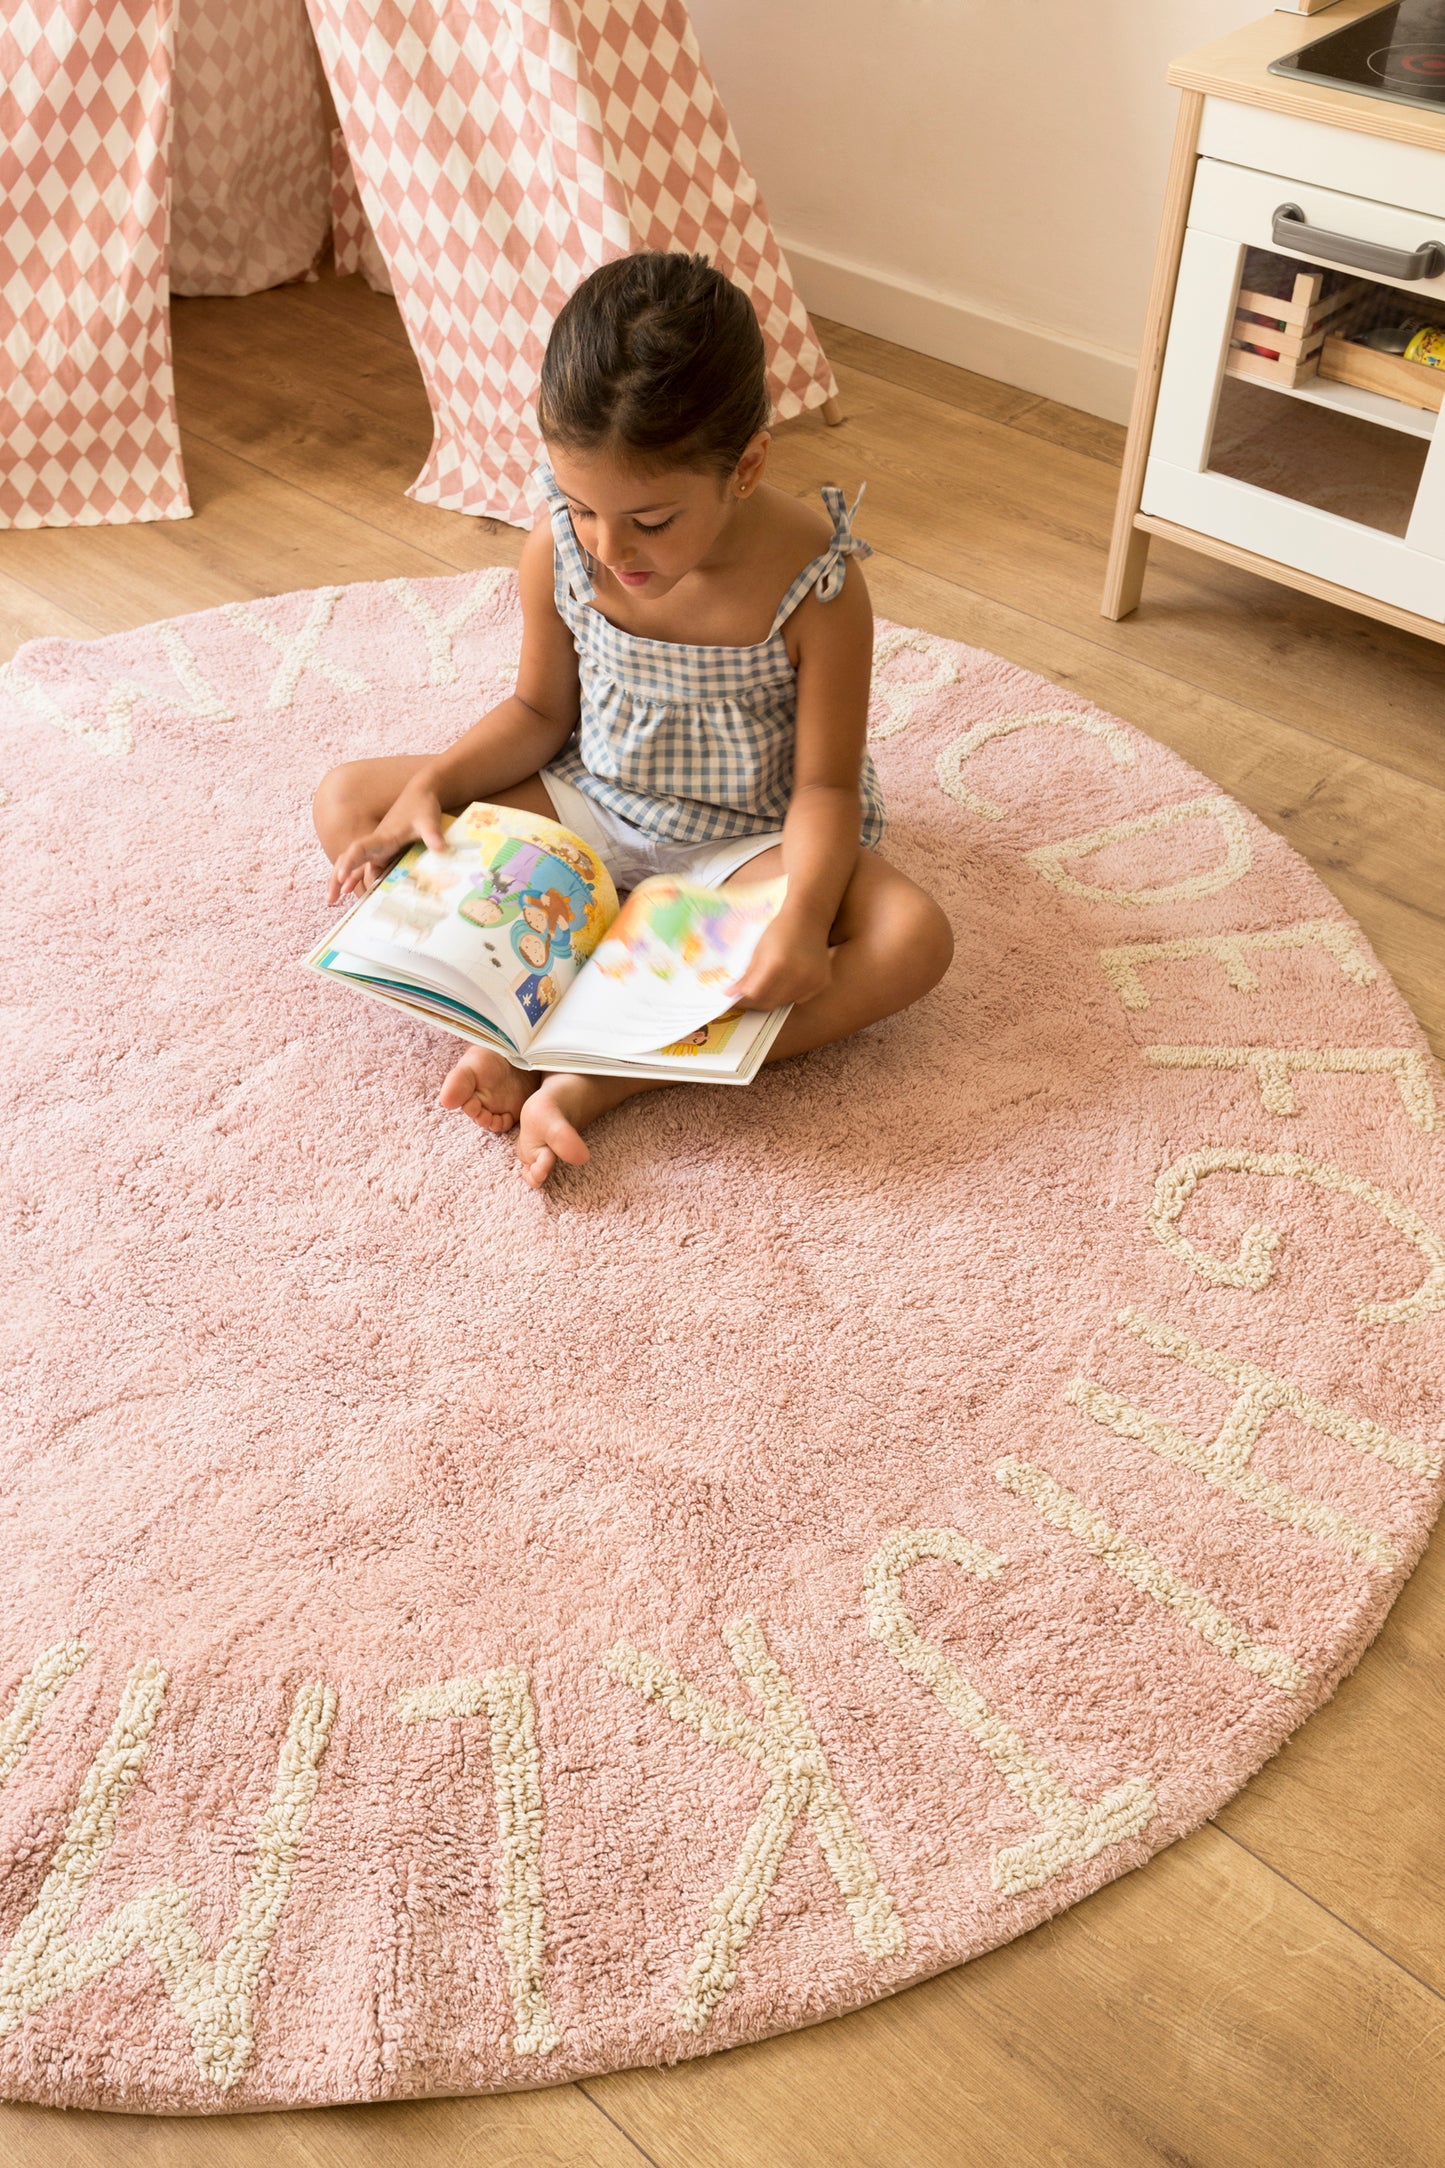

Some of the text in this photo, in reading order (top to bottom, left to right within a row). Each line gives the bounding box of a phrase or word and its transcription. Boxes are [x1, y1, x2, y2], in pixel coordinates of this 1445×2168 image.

[221, 584, 373, 712] X
[935, 709, 1138, 821] C
[1022, 794, 1253, 907] D
[1100, 918, 1378, 1010] E
[1142, 1043, 1442, 1132] F
[1149, 1147, 1445, 1326] G
[1064, 1306, 1444, 1572] H
[864, 1526, 1159, 1896] J
[0, 1656, 338, 2088] M
[397, 1663, 562, 2056] L
[603, 1616, 907, 2034] K
